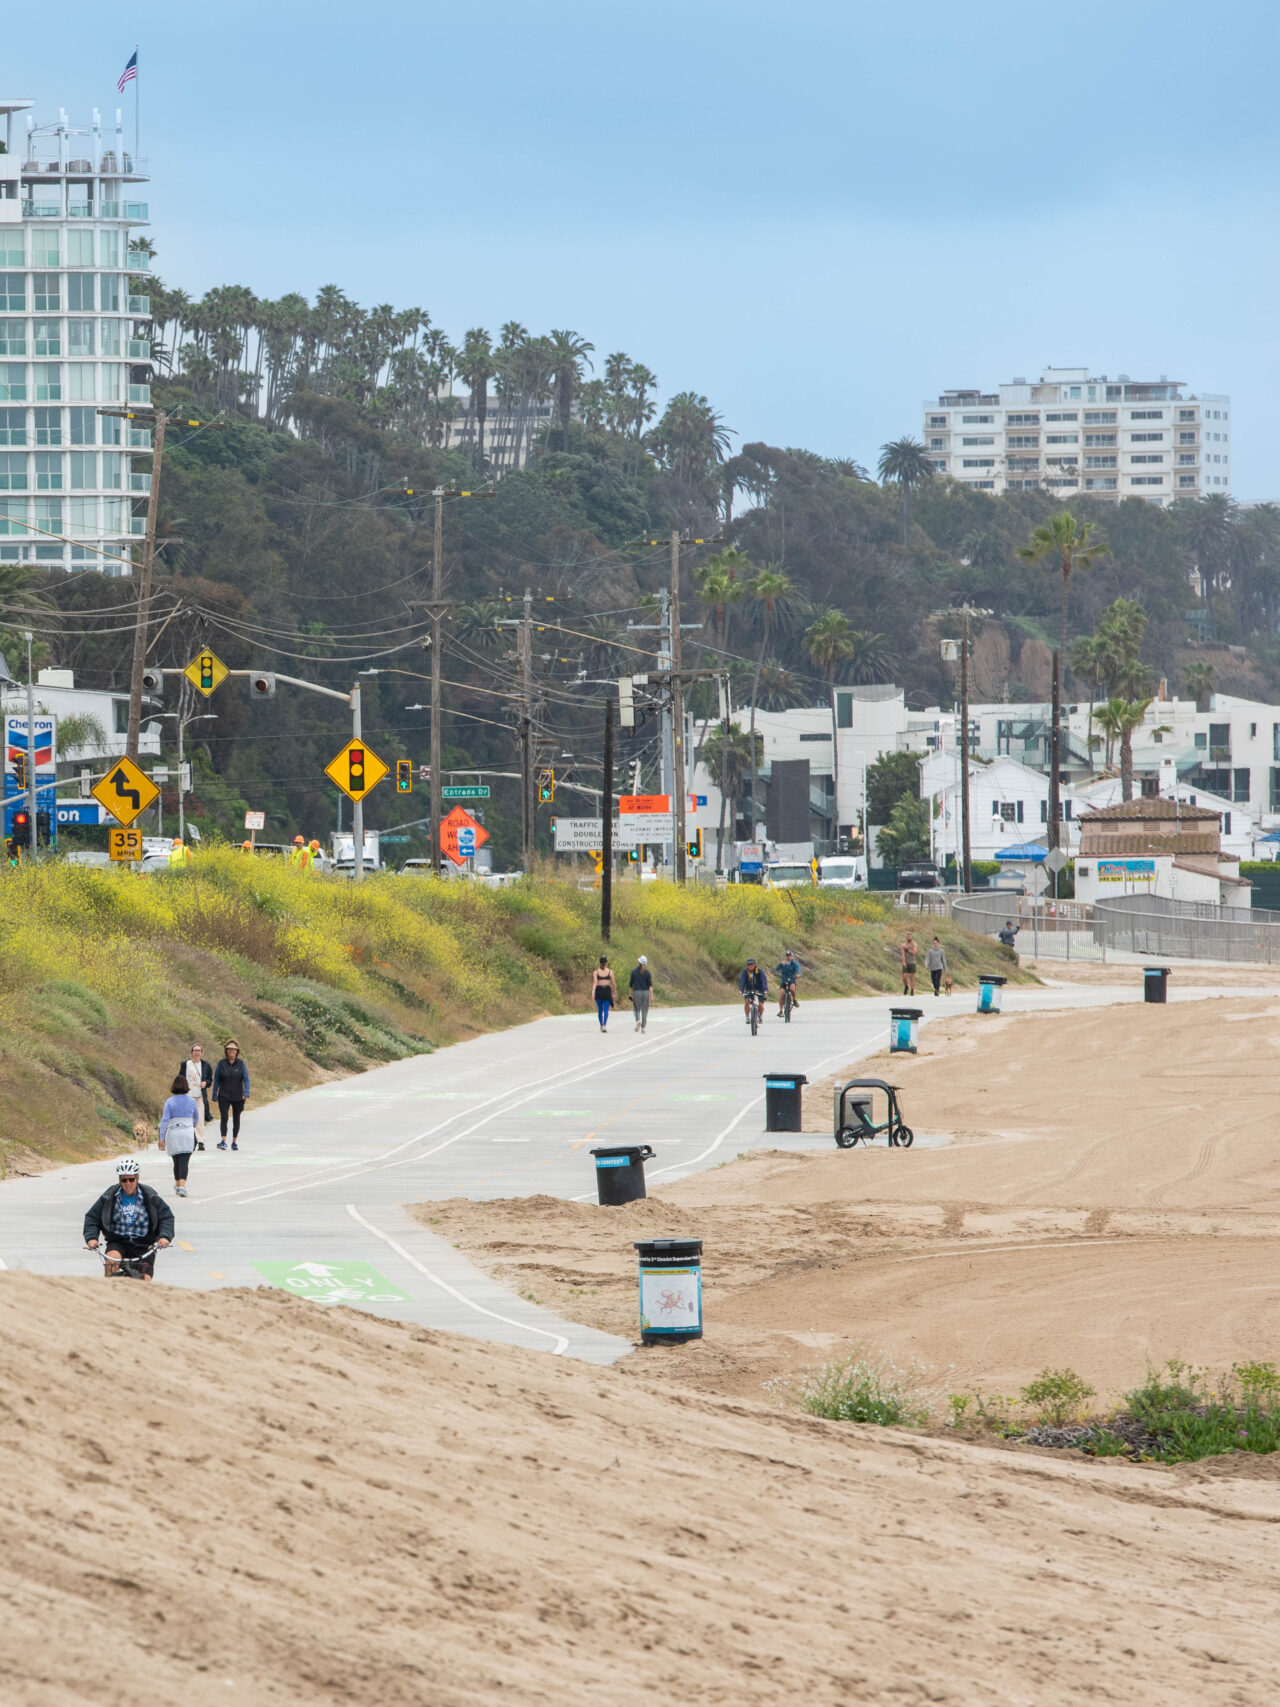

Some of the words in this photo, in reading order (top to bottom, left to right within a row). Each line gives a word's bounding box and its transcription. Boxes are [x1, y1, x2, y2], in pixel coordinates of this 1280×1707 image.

[8, 719, 52, 729] Cheron
[447, 819, 470, 828] ROAD
[114, 833, 138, 847] 35
[286, 1278, 376, 1287] ONLY
